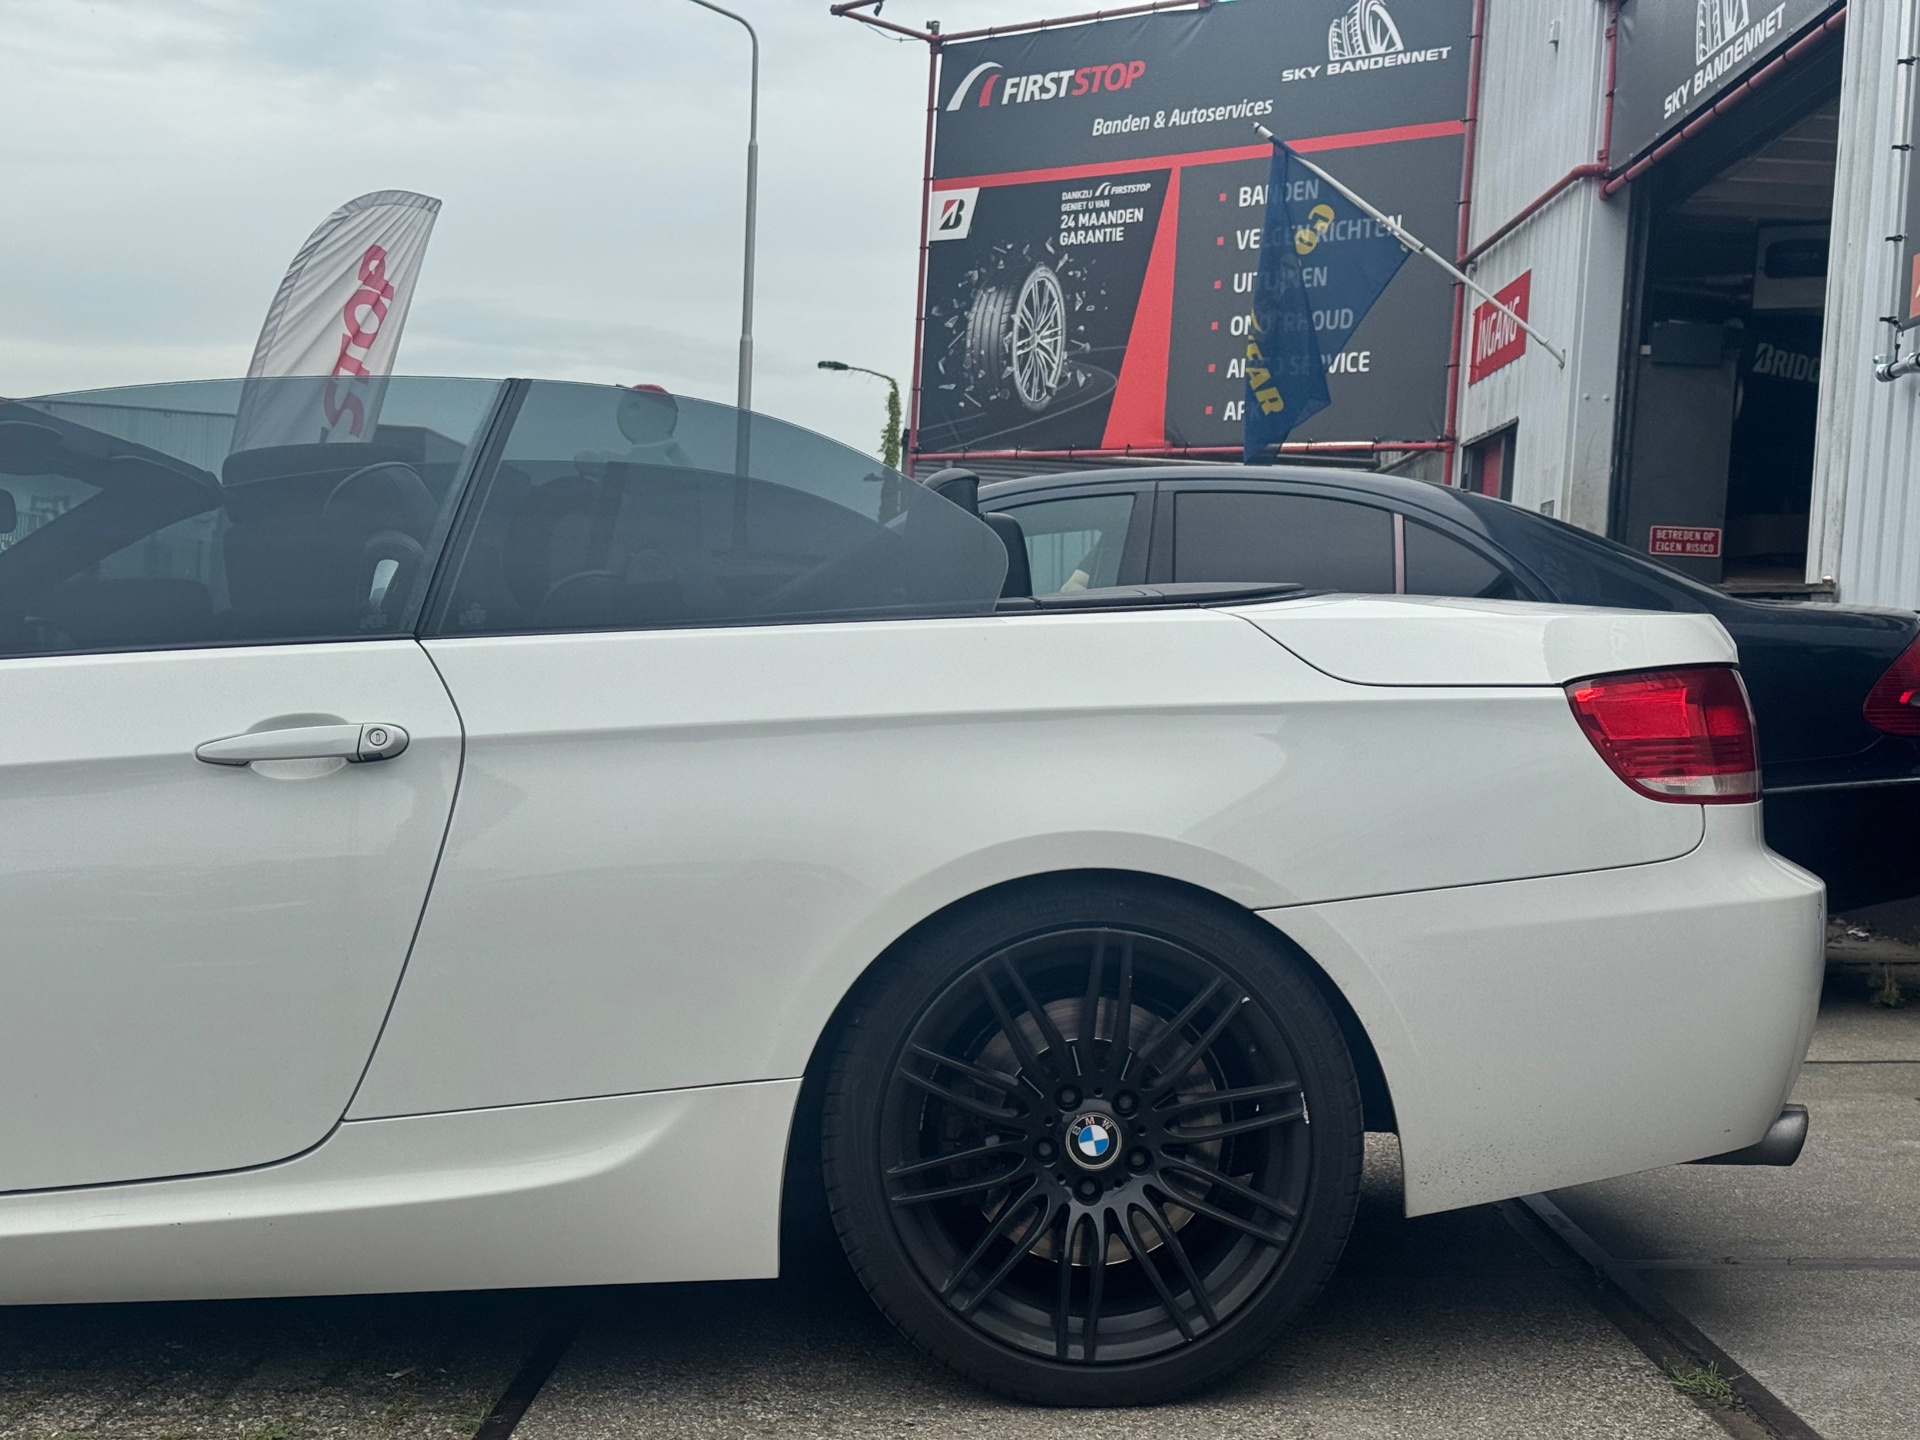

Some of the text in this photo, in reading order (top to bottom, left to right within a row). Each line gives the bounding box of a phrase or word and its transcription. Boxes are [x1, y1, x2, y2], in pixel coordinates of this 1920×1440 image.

[1281, 46, 1452, 82] SKY BANDENNET
[1664, 2, 1786, 120] SKY BANDENNET
[1001, 60, 1146, 106] FIRSTSTOP
[1092, 98, 1274, 137] Banden & Autoservices
[1110, 182, 1152, 196] FIRSTSTOP
[1061, 199, 1110, 212] GENIET U VAN
[1060, 207, 1144, 229] 24 MAANDEN
[1059, 226, 1125, 246] GARANTIE
[323, 244, 395, 438] STOP
[1476, 295, 1520, 366] INGANG
[1656, 529, 1716, 542] BETREDEN OP
[1655, 541, 1715, 553] EIGEN RISICO
[1071, 1116, 1113, 1136] BMW
